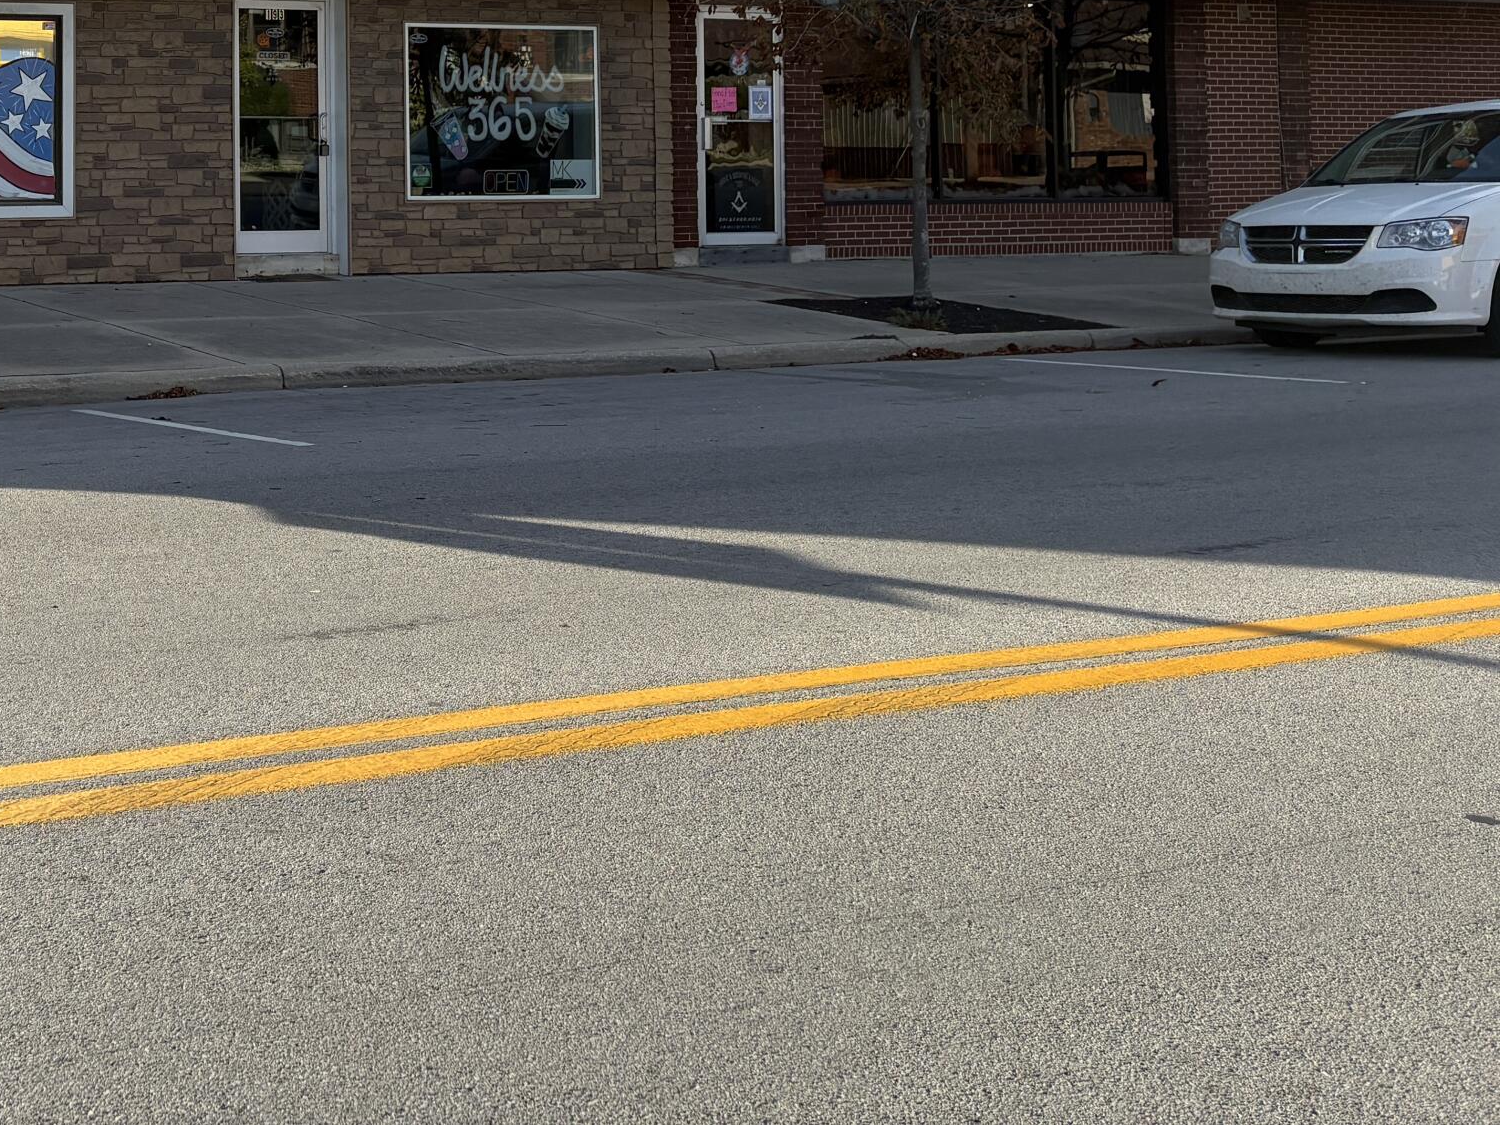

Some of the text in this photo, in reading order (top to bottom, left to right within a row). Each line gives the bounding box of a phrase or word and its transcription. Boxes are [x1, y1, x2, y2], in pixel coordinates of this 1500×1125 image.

[265, 9, 285, 21] 193
[438, 44, 565, 93] Wellness
[466, 96, 537, 142] 365
[484, 172, 528, 193] OPEN
